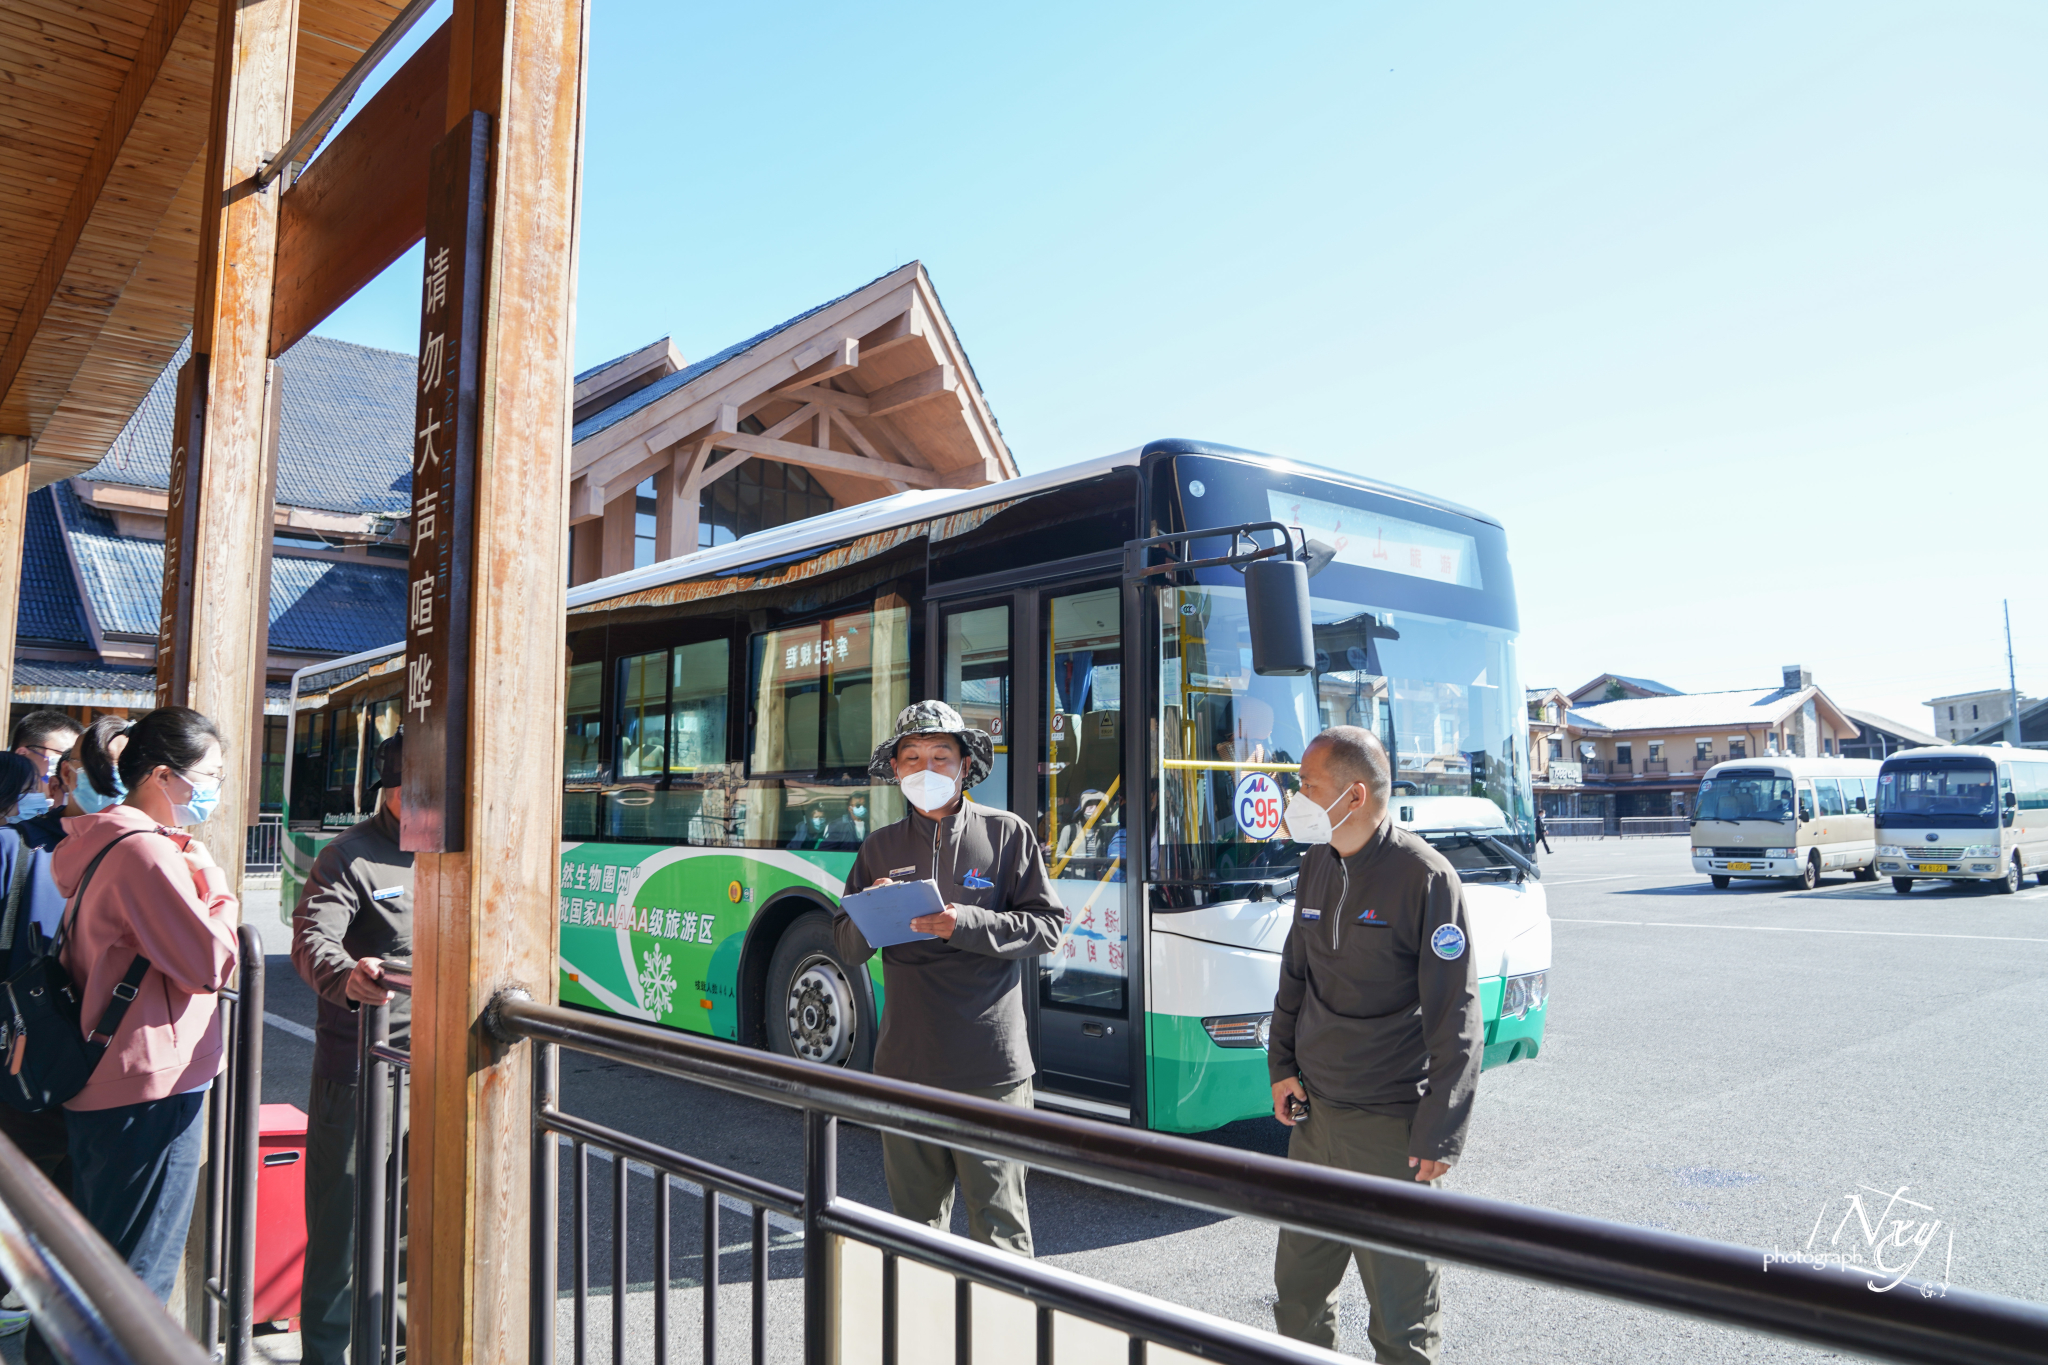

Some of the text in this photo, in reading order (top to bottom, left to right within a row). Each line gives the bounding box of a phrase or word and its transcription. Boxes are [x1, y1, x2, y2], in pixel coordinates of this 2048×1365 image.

[407, 246, 449, 723] 请勿大声喧哗
[440, 448, 452, 514] KEEP
[437, 530, 449, 603] QUIET
[1240, 797, 1279, 829] C95
